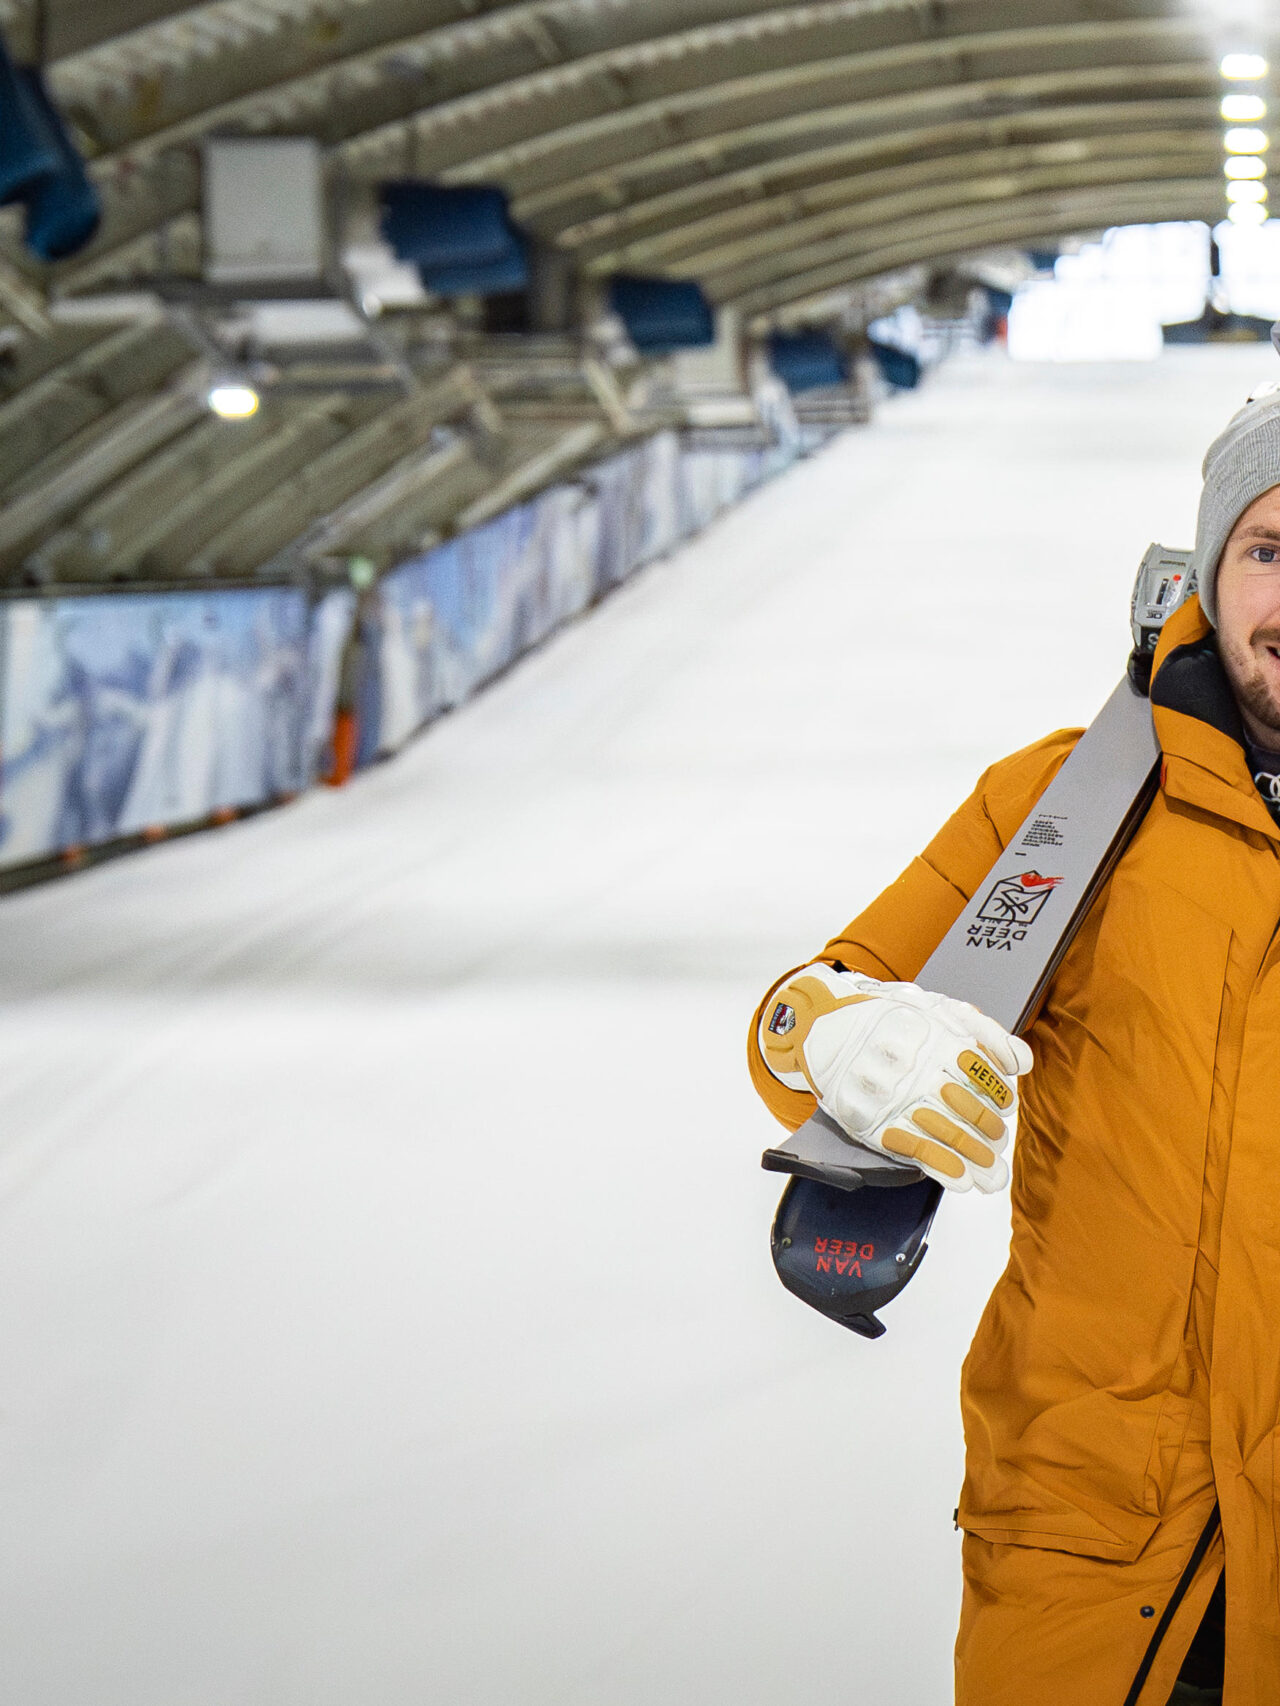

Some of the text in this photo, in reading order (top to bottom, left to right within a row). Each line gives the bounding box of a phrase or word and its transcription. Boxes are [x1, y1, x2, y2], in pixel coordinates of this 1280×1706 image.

[966, 923, 1028, 941] DEER
[966, 936, 1012, 951] VAN
[969, 1061, 1008, 1104] HESTRA
[813, 1236, 875, 1261] DEER
[816, 1255, 863, 1278] VAN
